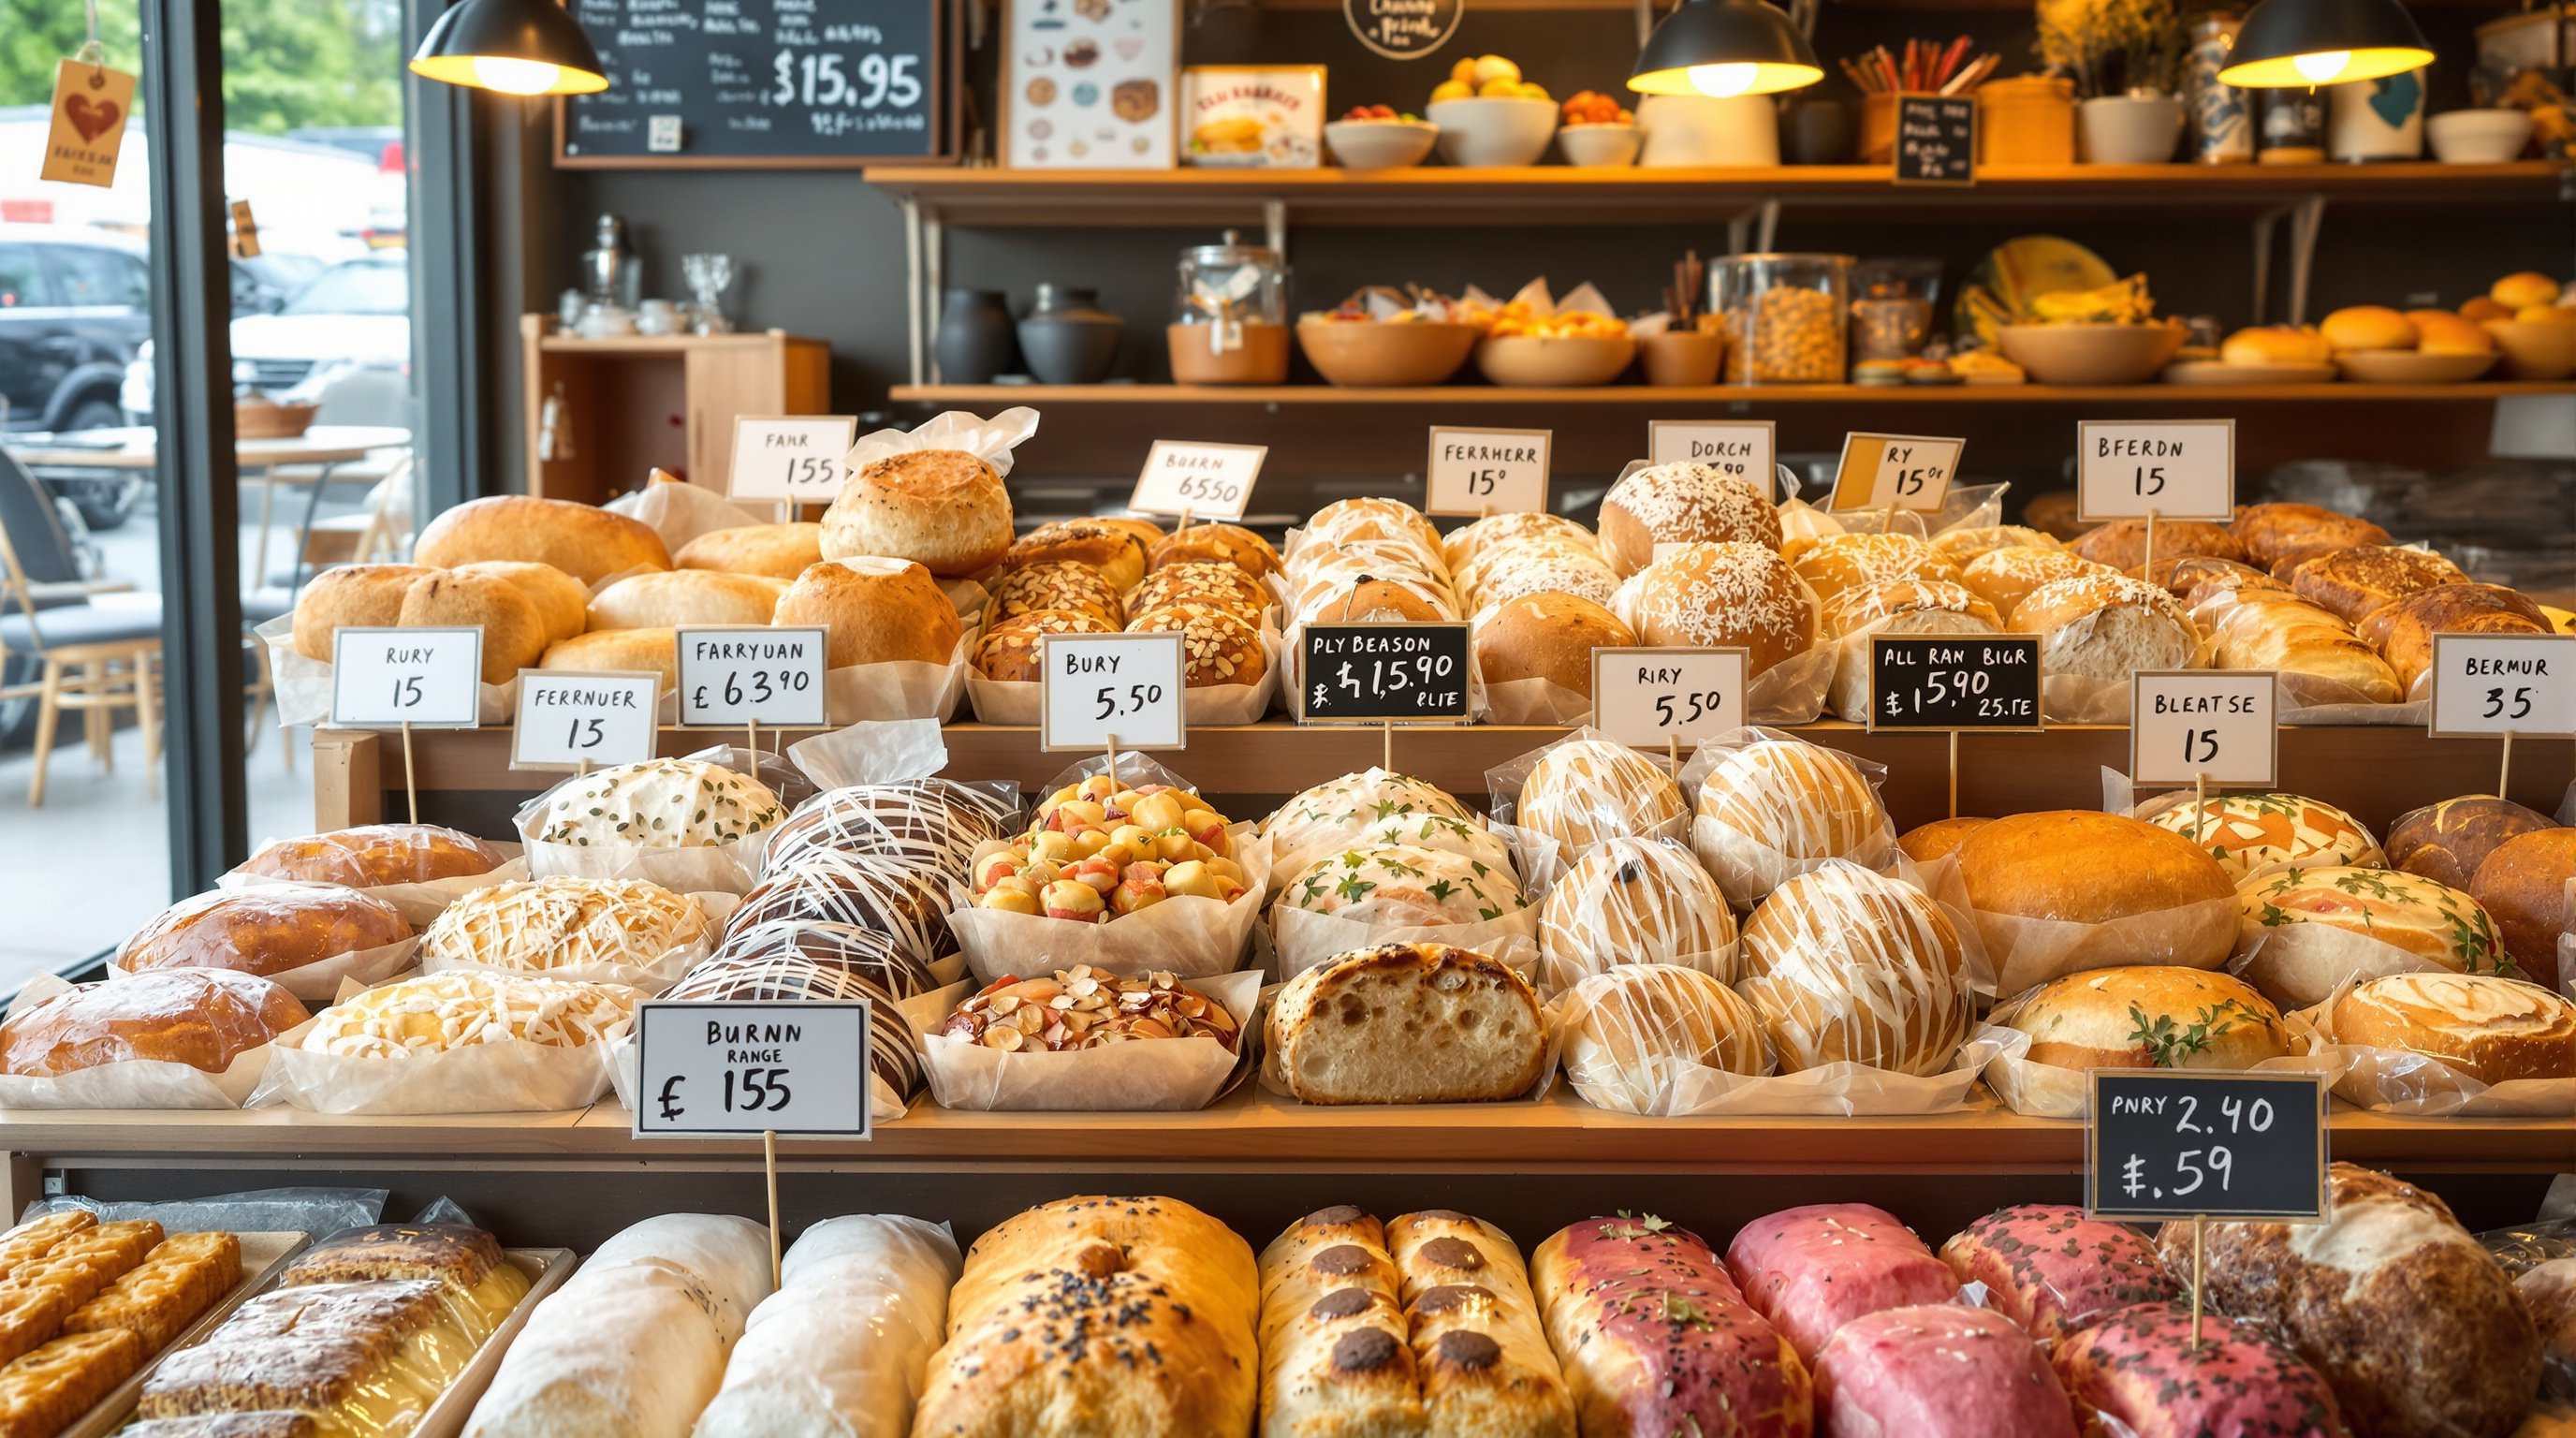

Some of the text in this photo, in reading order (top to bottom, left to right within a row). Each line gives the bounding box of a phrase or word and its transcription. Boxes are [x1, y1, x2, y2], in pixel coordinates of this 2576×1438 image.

[772, 47, 923, 111] $15.95
[1887, 447, 1912, 463] RY
[2099, 437, 2183, 457] BFERDN
[787, 458, 833, 484] 155
[2135, 466, 2165, 496] 15
[1178, 476, 1239, 503] 6550
[387, 647, 434, 664] RURY
[696, 641, 803, 661] FARRYUAN
[1313, 636, 1431, 655] PLY BEASON
[1884, 648, 1917, 667] ALL
[1928, 647, 1965, 666] RAN
[1066, 653, 1121, 675] BURY
[1638, 668, 1683, 685] RIRY
[2466, 657, 2549, 677] BERMUR
[393, 676, 424, 708] 15
[534, 689, 637, 709] FERRNUER
[1095, 684, 1163, 721] 5.50
[1655, 691, 1721, 727] 5.50
[568, 718, 605, 749] 15
[2184, 728, 2219, 763] 15
[707, 1020, 802, 1046] BURNN
[727, 1049, 783, 1064] RANGE
[724, 1068, 792, 1112] 155
[2112, 1095, 2275, 1135] PNRY 2.40
